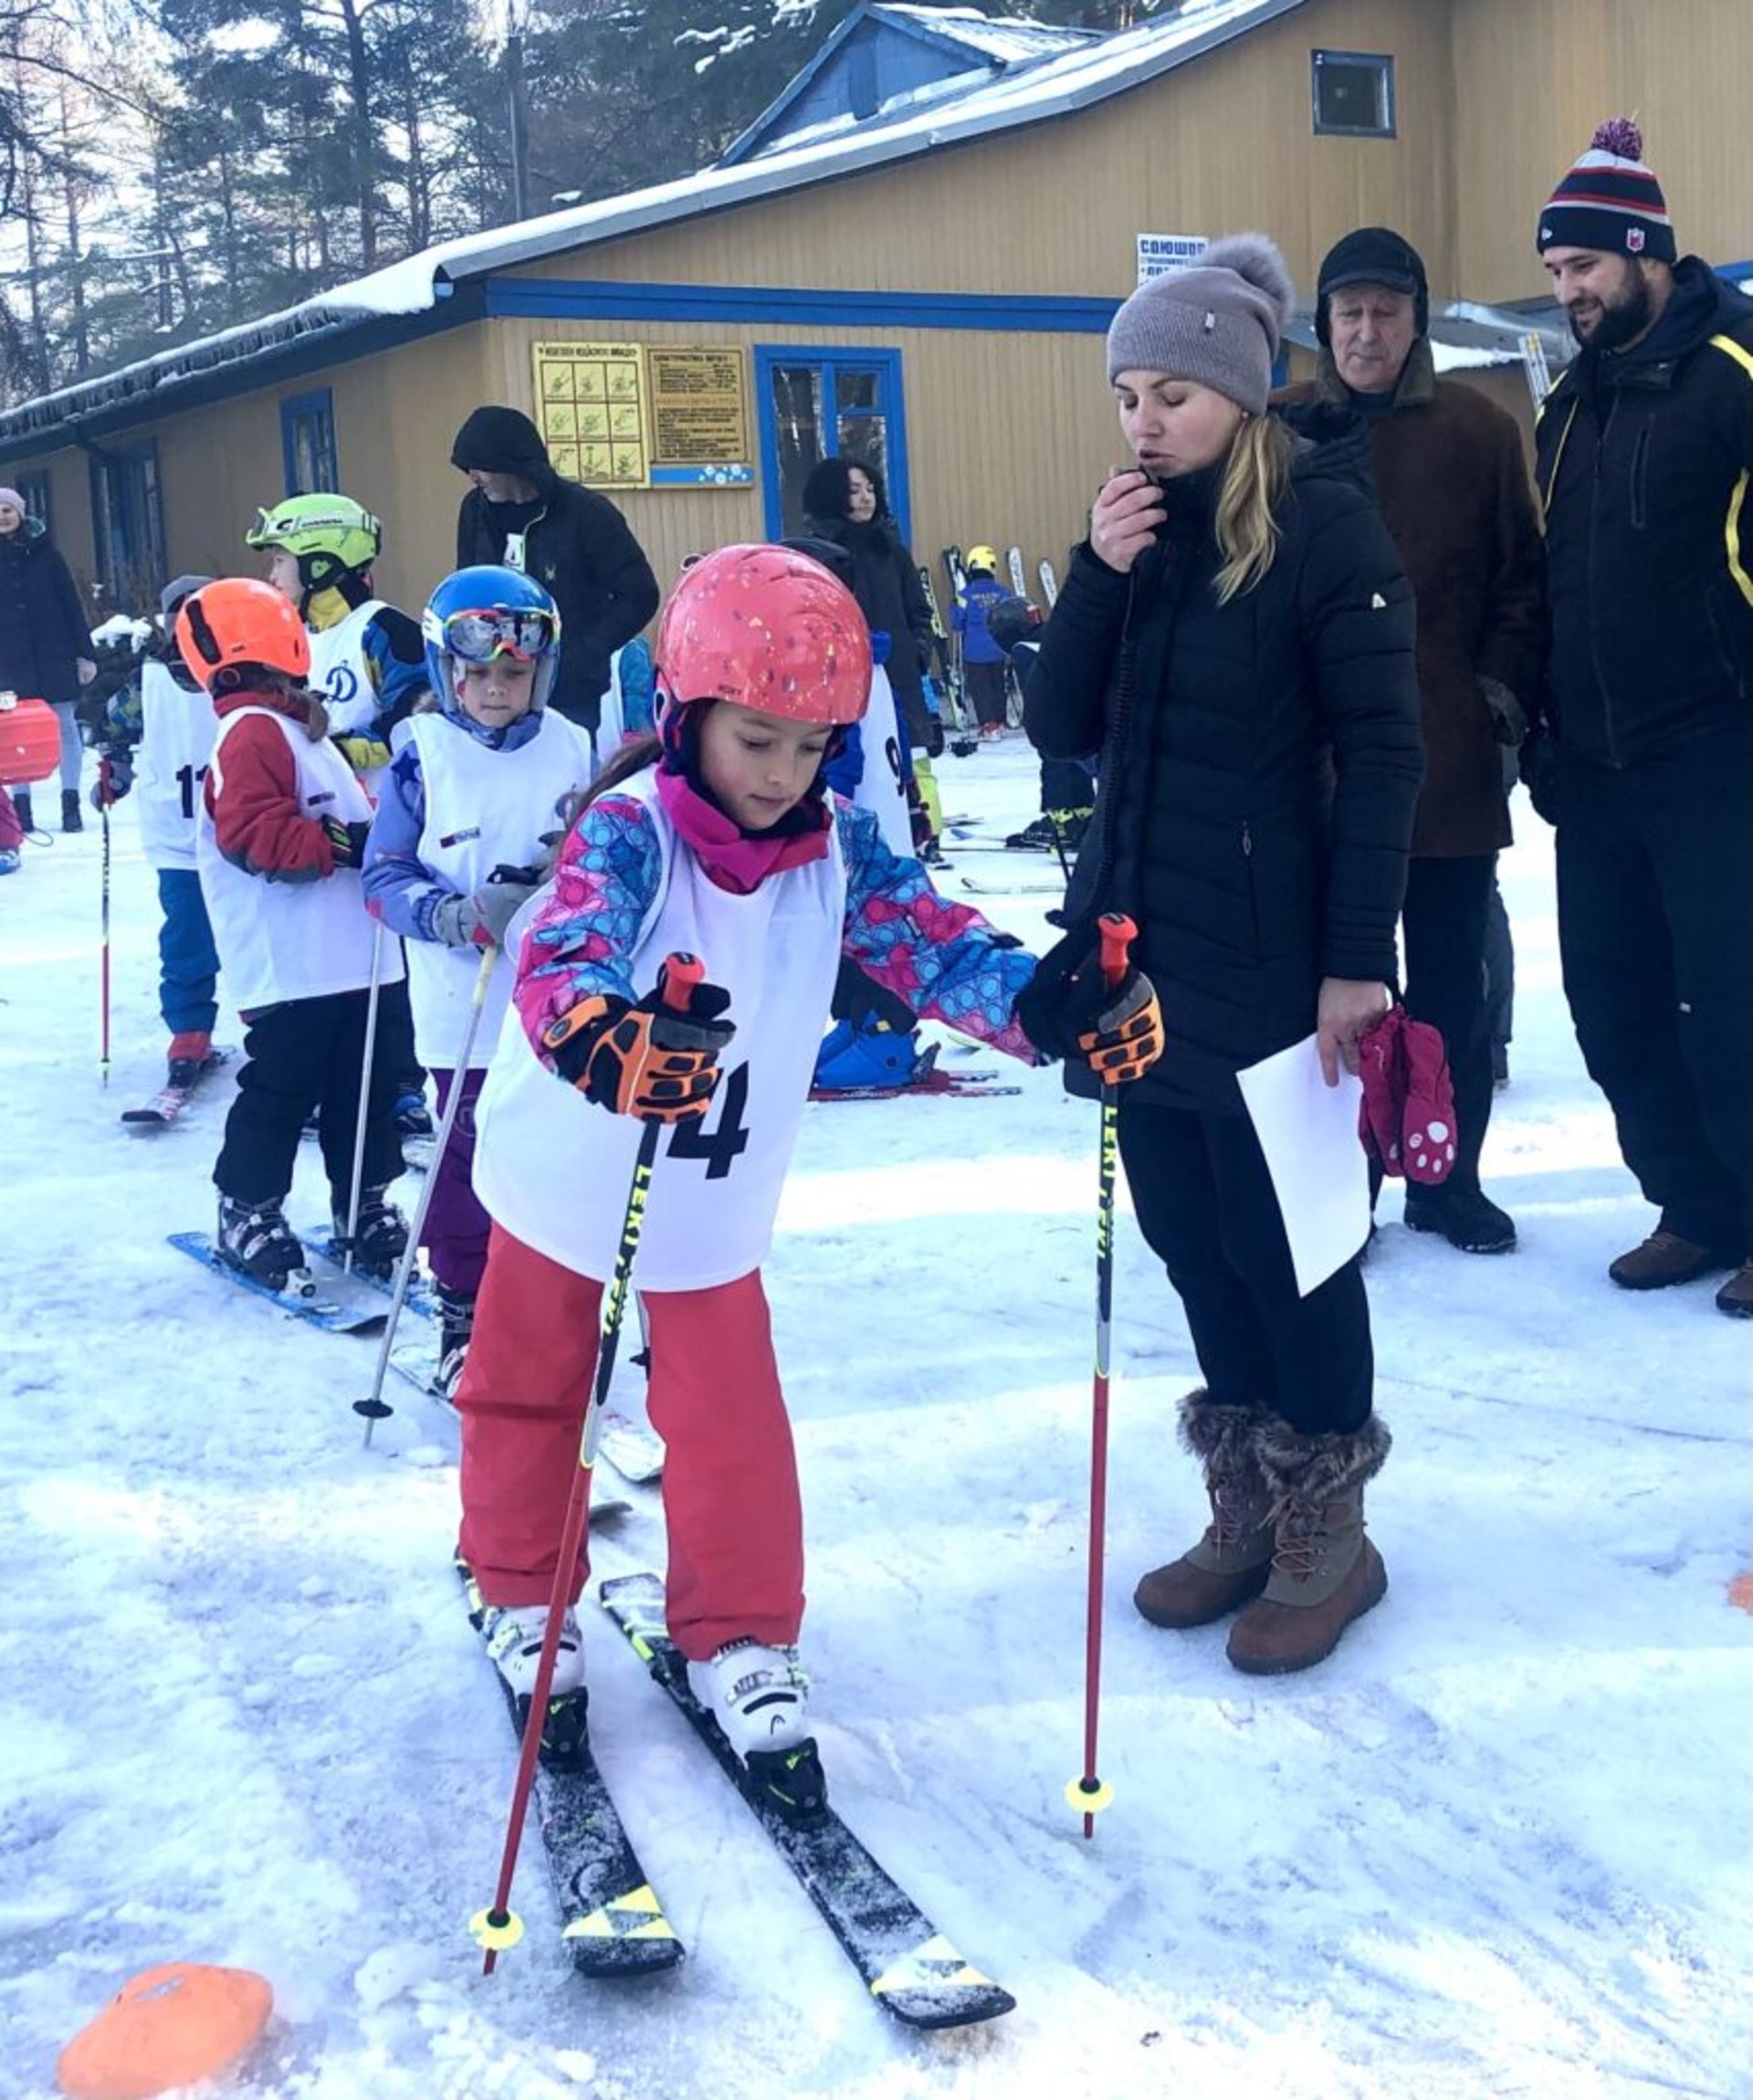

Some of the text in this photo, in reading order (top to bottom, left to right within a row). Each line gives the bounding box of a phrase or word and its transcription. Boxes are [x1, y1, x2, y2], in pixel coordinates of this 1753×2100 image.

[667, 1060, 750, 1180] 4
[1103, 1106, 1118, 1179] LEKI
[624, 1163, 653, 1247] LEKI
